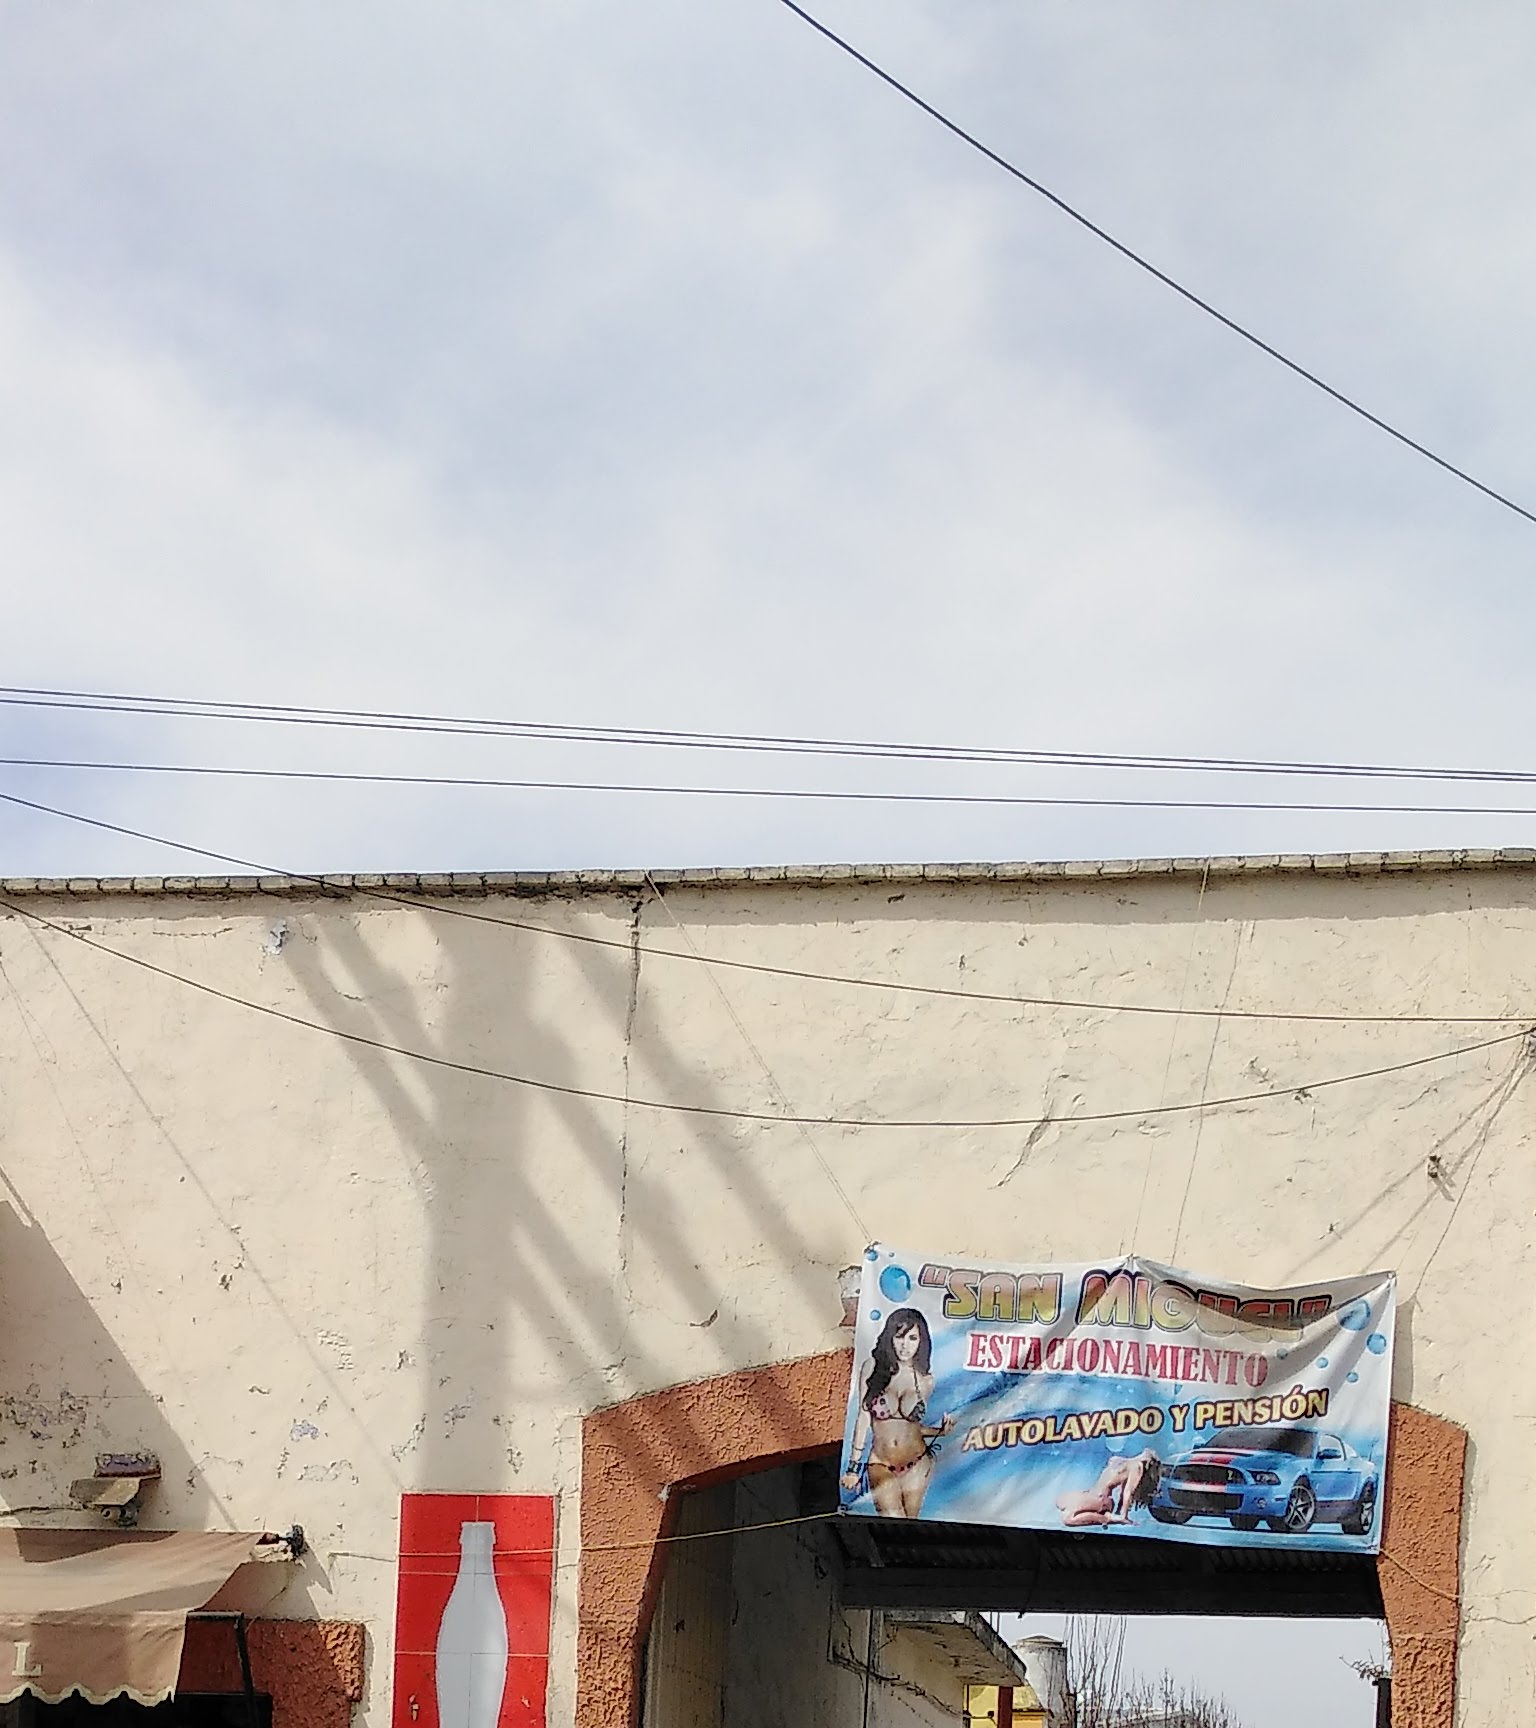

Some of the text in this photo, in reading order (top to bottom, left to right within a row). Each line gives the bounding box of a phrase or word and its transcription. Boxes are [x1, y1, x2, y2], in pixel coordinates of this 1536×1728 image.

[966, 1332, 1270, 1388] ESTACIONAMIENTO
[962, 1386, 1330, 1453] AUTOLAVADO Y PENSIÓN
